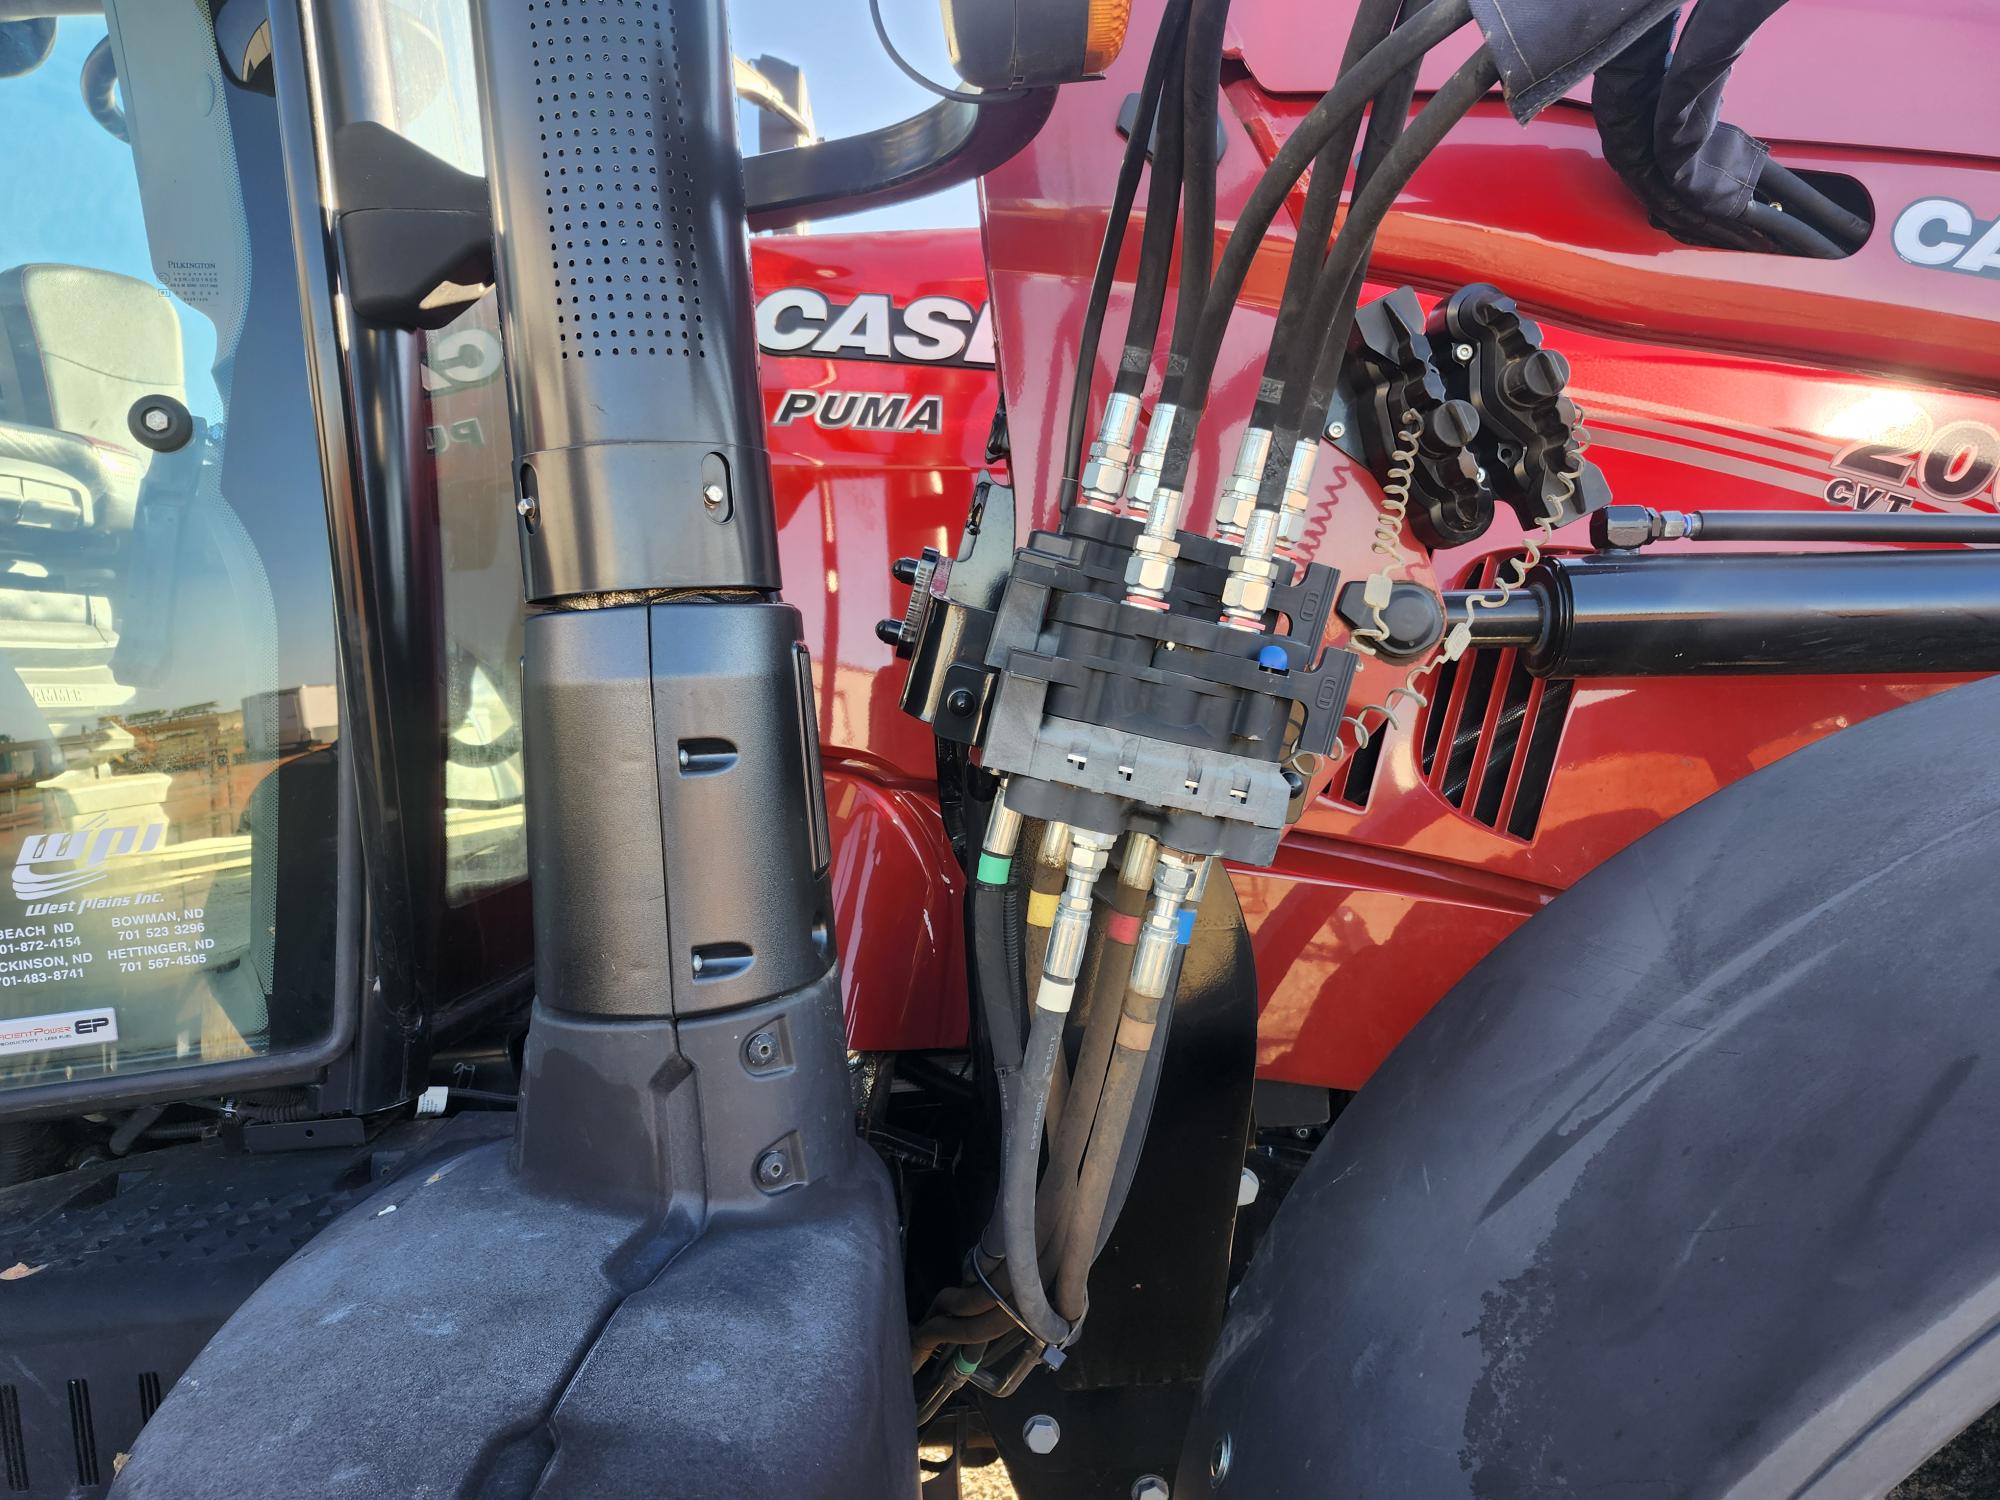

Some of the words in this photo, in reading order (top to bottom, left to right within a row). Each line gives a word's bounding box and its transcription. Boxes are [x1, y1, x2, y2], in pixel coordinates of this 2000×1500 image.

[772, 388, 943, 434] PUMA
[1829, 400, 2000, 503] 20
[1824, 477, 1915, 513] CVT
[25, 900, 76, 917] West
[77, 896, 131, 915] Plains
[134, 893, 165, 905] Inc.
[111, 911, 181, 928] BOWMAN,
[184, 908, 205, 920] ND
[53, 922, 75, 935] ND
[118, 930, 140, 941] 701
[146, 926, 169, 938] 523
[174, 922, 205, 935] 3296
[195, 939, 215, 950] ND
[72, 953, 93, 965] ND
[120, 961, 142, 973] 701
[148, 953, 207, 970] 567-4505
[0, 967, 84, 987] 01-483-8741
[75, 1017, 109, 1034] EP
